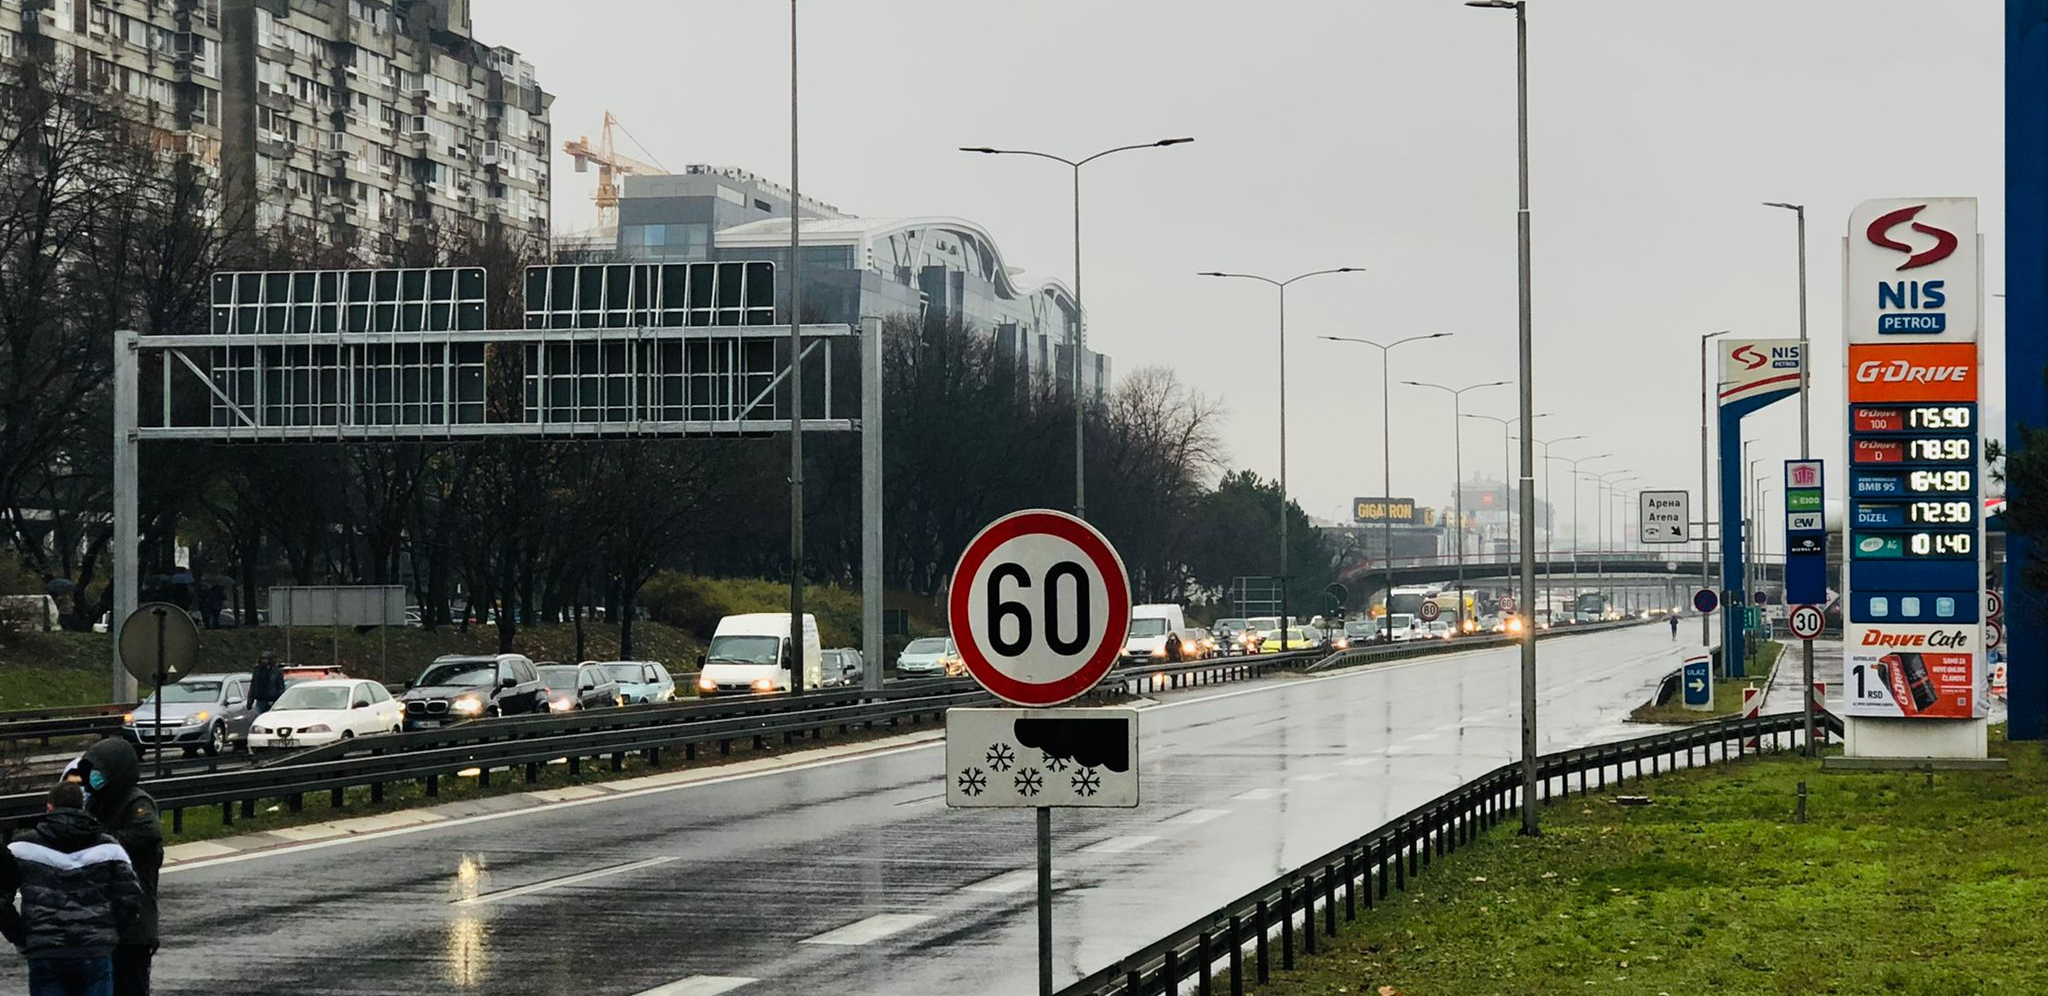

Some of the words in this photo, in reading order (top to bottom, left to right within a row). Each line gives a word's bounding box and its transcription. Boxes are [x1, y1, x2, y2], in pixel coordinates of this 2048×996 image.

[1878, 281, 1946, 309] NIS
[1884, 317, 1940, 329] PETROL
[1772, 347, 1799, 358] NIS
[1910, 407, 1970, 428] 175.90
[1870, 420, 1887, 429] 100
[1910, 439, 1970, 460] 178.90
[1875, 451, 1883, 461] D
[1858, 482, 1882, 491] BMB
[1883, 482, 1896, 491] 95
[1910, 471, 1970, 491] 164.90
[1648, 499, 1681, 510] Арена
[1648, 513, 1679, 521] Arena
[1858, 513, 1888, 522] DIZEL
[1911, 502, 1971, 522] 172.90
[987, 561, 1091, 657] 60
[1423, 605, 1435, 616] 80
[1796, 613, 1818, 631] 30
[1861, 629, 1926, 648] DRIVE
[1928, 630, 1968, 649] Cafe
[1852, 665, 1865, 698] 1
[1868, 691, 1883, 699] RSD
